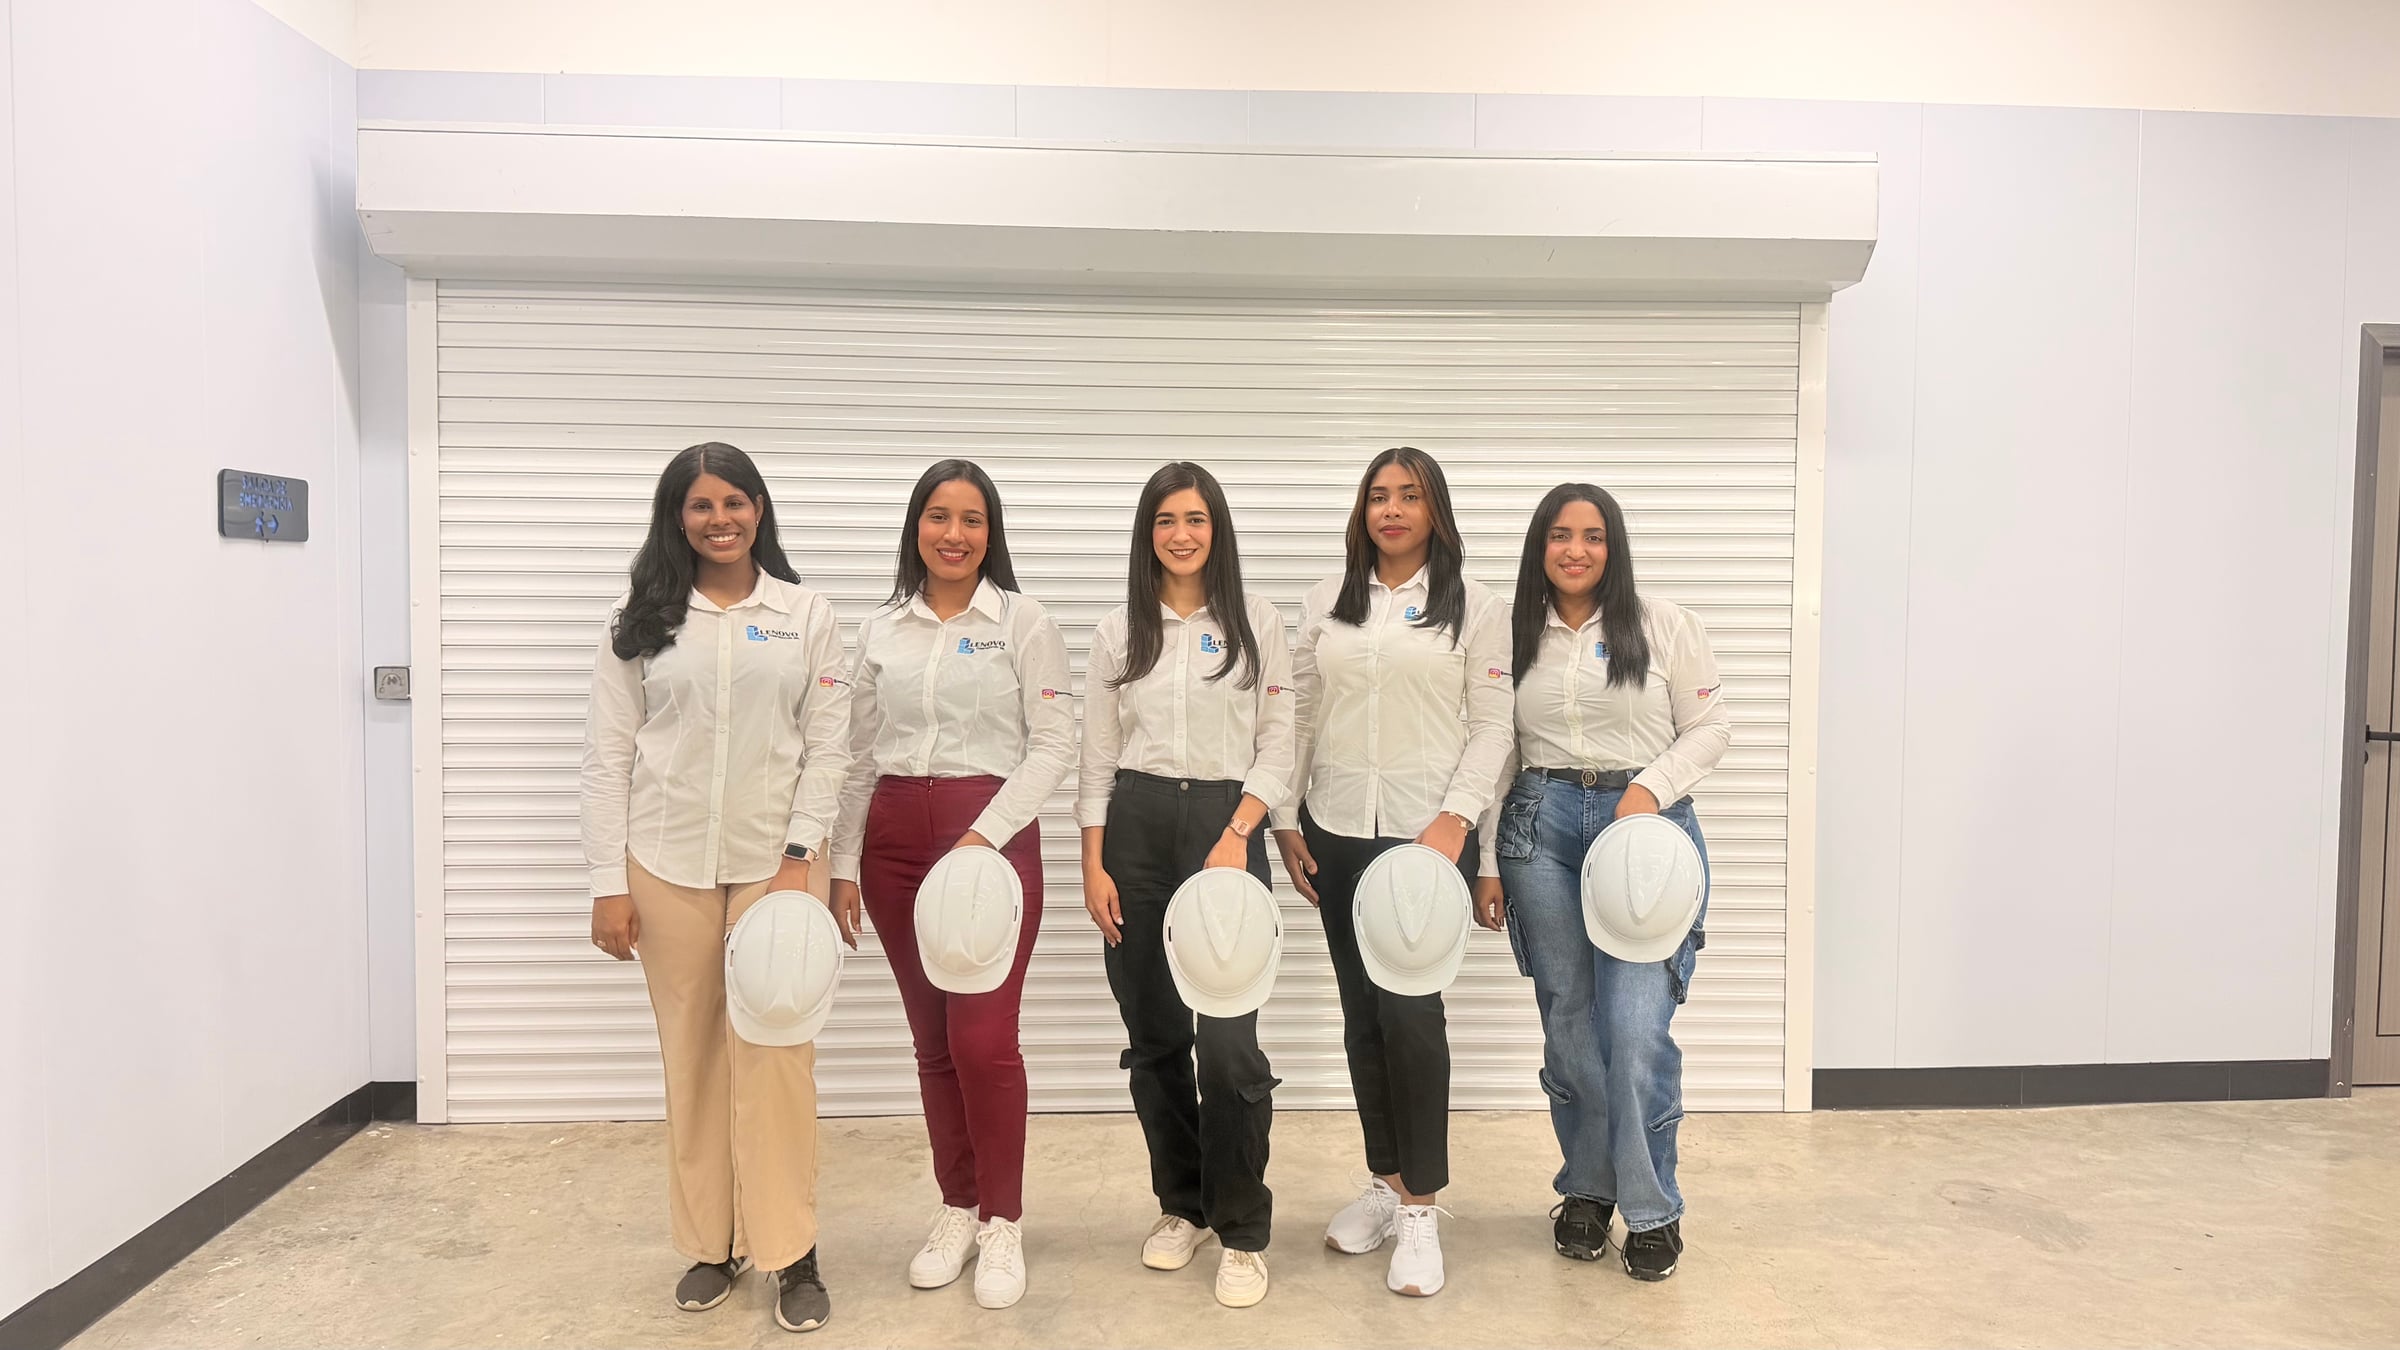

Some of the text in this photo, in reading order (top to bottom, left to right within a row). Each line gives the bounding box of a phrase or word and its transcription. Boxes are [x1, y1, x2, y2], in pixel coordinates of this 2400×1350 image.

[242, 475, 274, 493] SALIDA
[760, 629, 798, 637] LENOVO
[970, 640, 1005, 648] LENOVO
